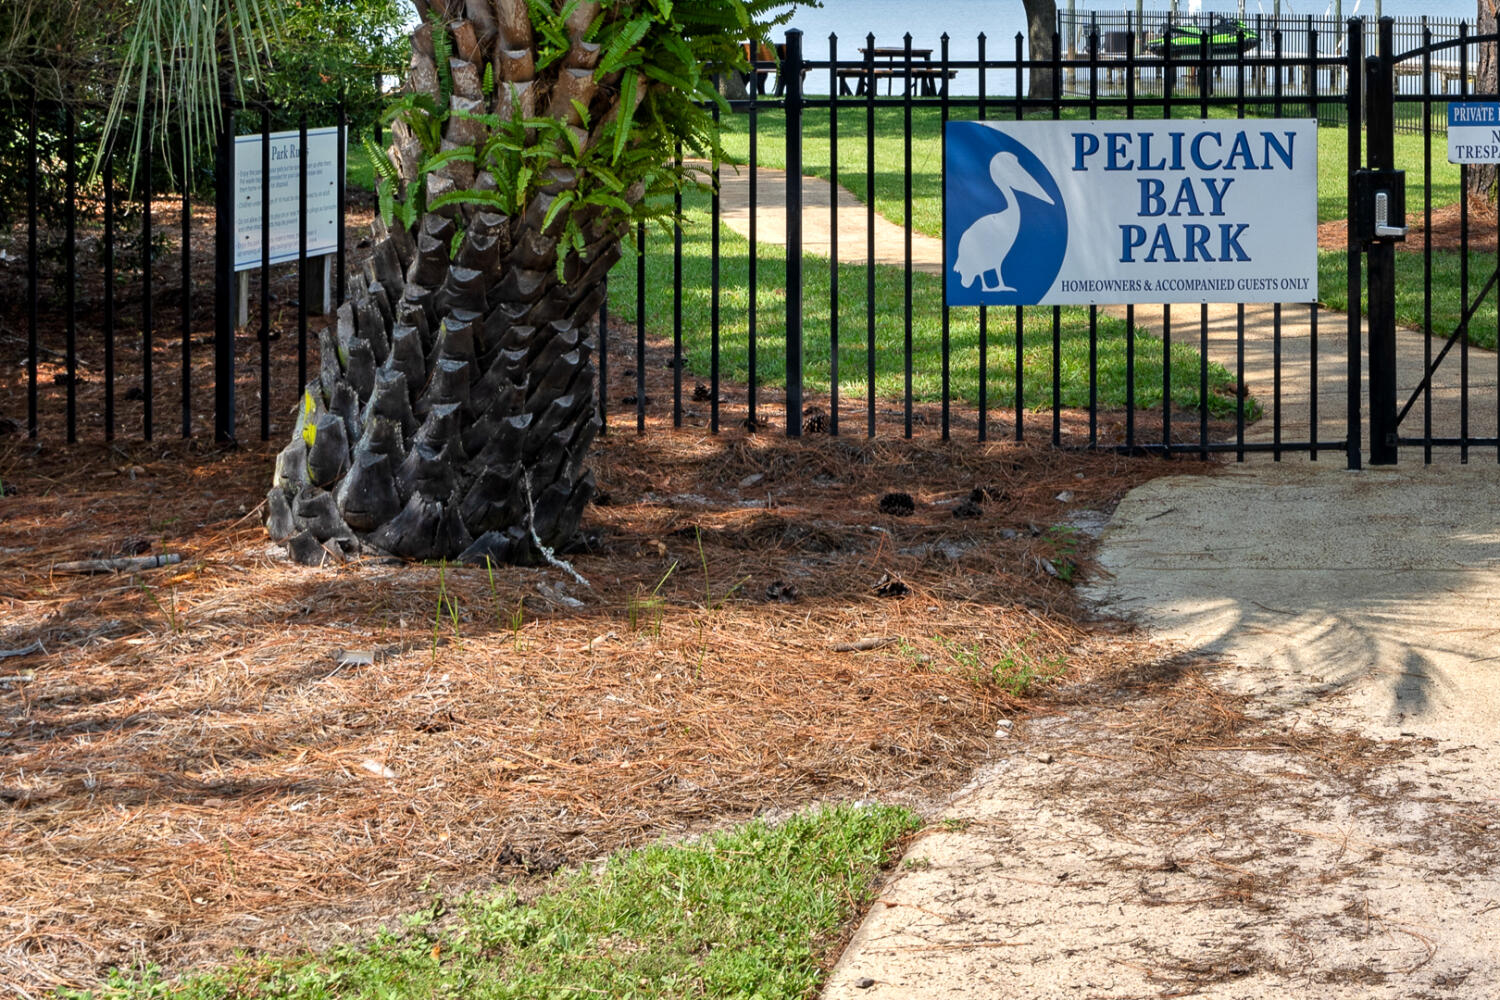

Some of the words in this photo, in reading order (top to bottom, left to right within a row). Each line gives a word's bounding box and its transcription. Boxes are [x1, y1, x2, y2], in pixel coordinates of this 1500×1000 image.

[1453, 107, 1493, 121] PRIVATE
[271, 145, 288, 160] Park
[1071, 131, 1296, 171] PELICAN
[1137, 177, 1235, 217] BAY
[1119, 223, 1251, 263] PARK
[1061, 279, 1142, 292] HOMEOWNERS
[1143, 280, 1153, 291] &
[1155, 278, 1235, 292] ACCOMPANIED
[1237, 278, 1278, 291] GUESTS
[1281, 277, 1310, 291] ONLY
